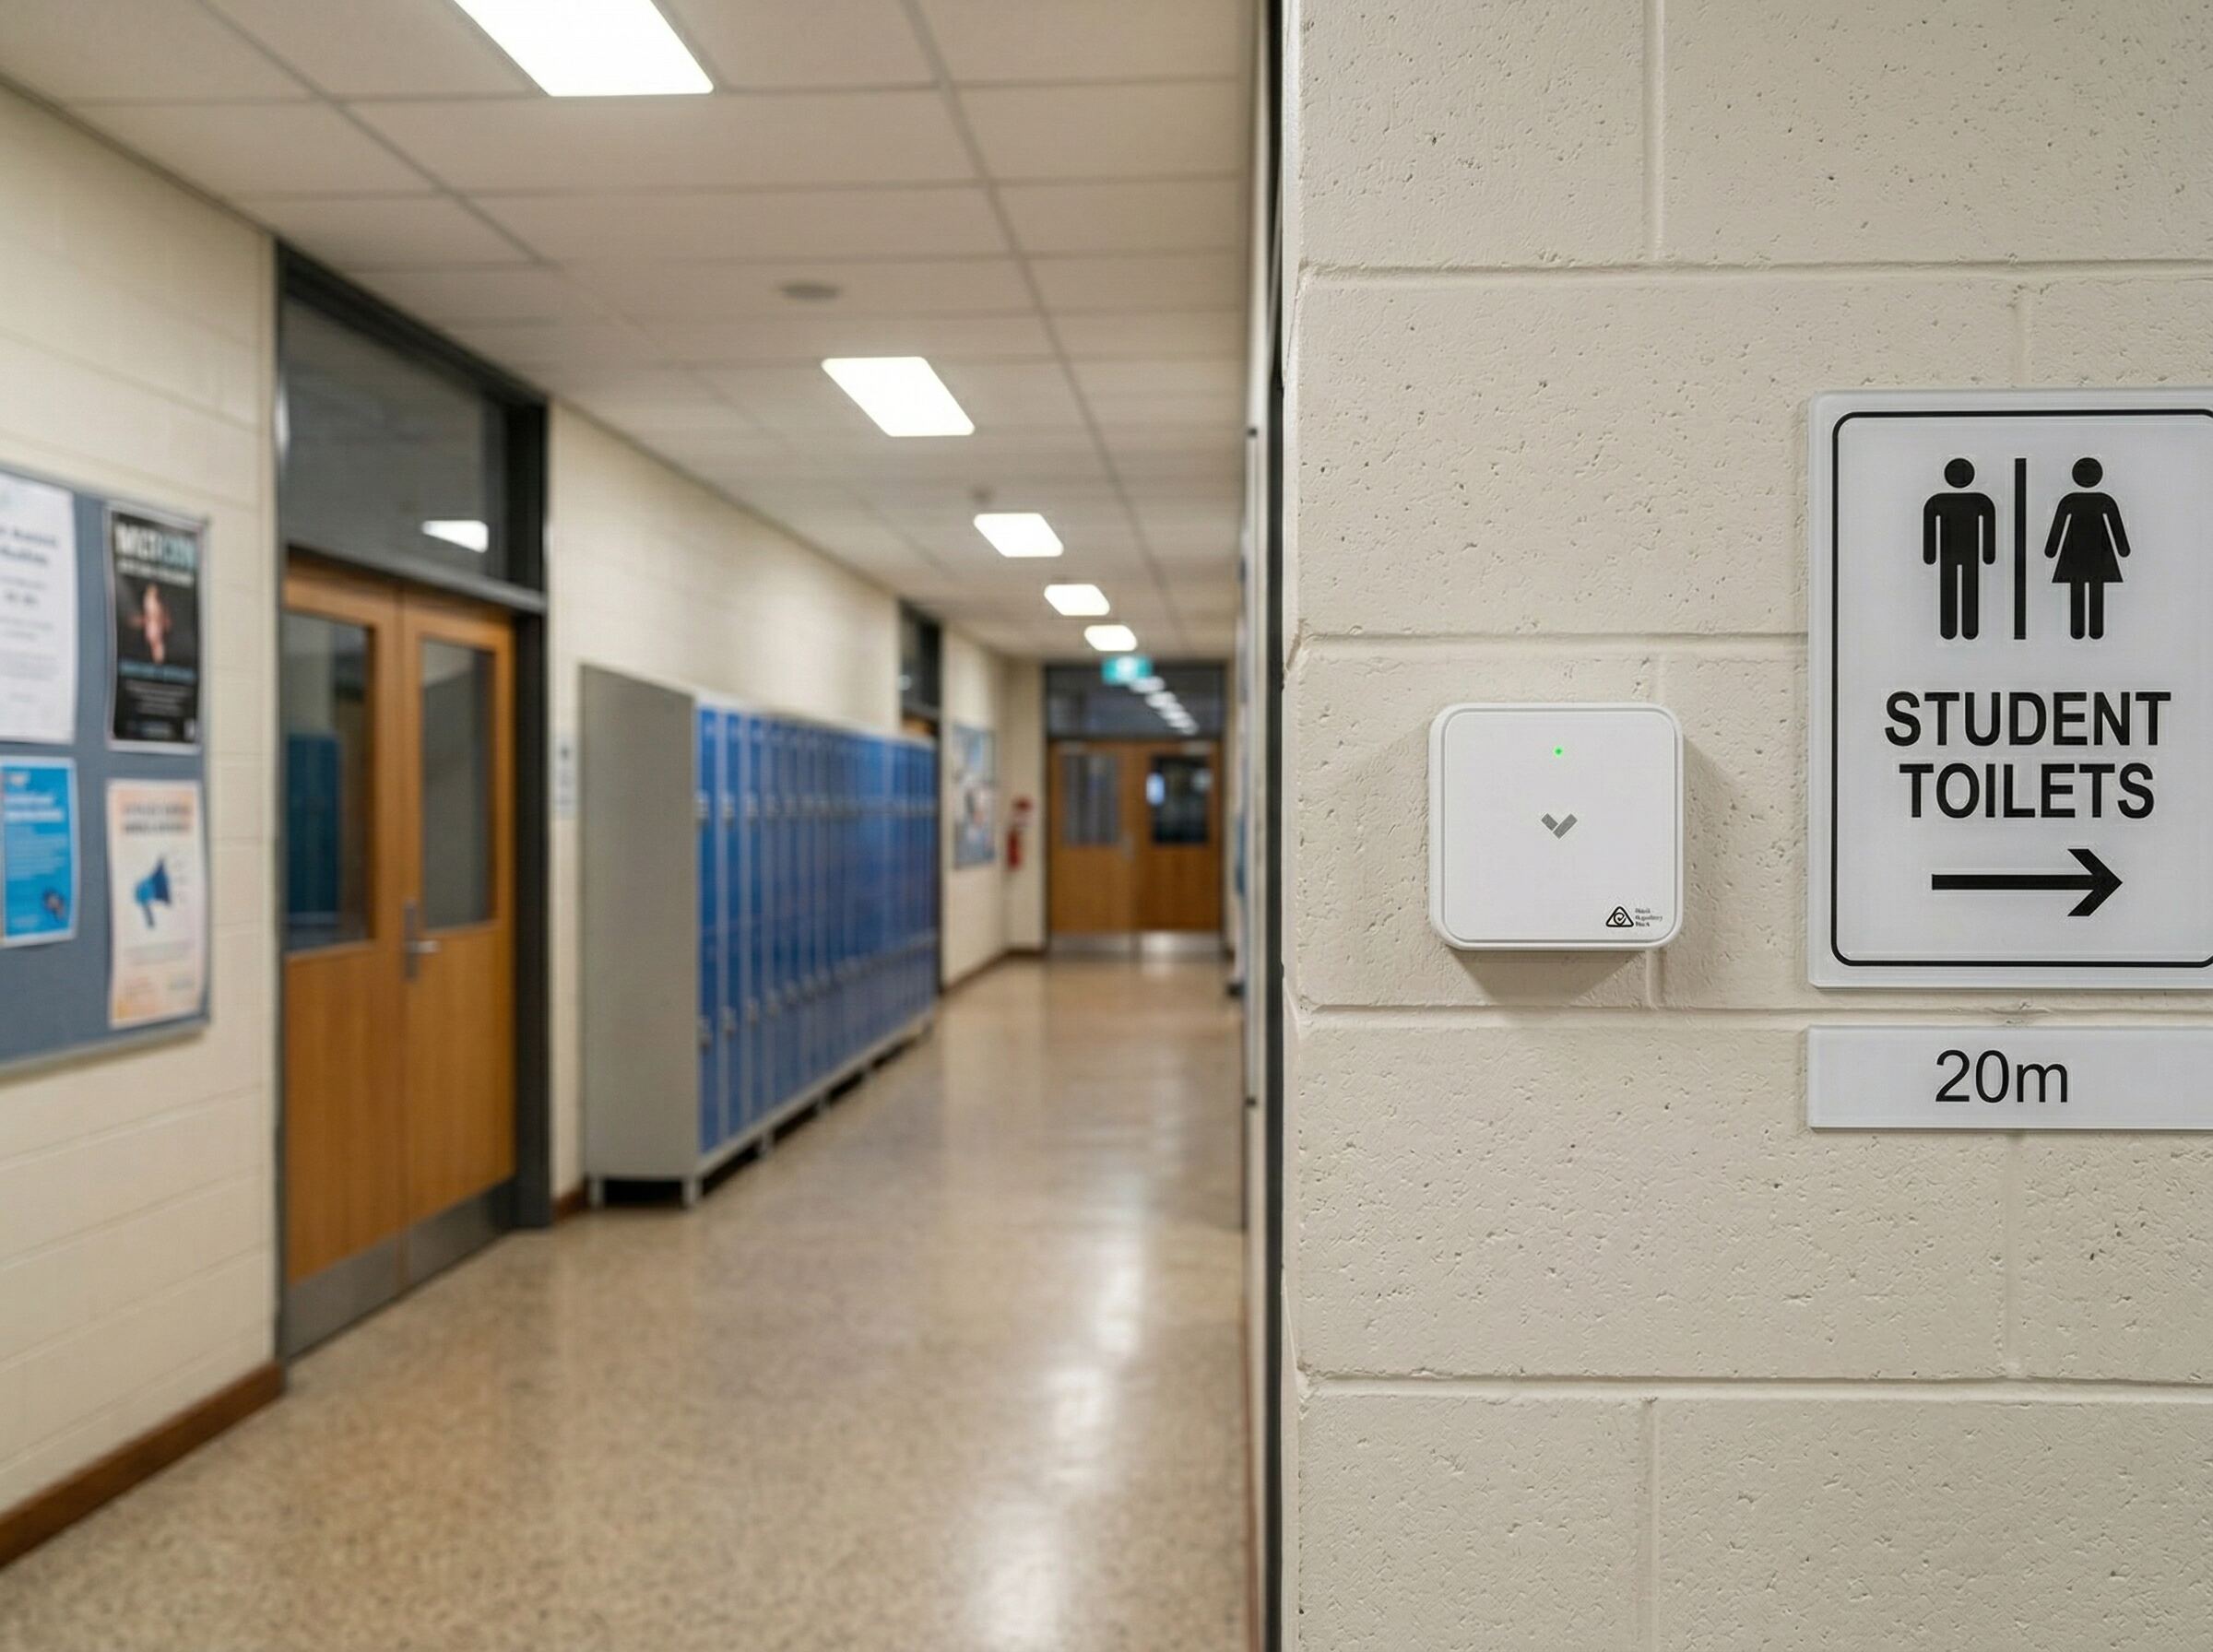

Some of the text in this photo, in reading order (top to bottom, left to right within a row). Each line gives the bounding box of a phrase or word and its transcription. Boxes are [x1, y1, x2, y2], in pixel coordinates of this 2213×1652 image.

[1884, 690, 2172, 748] STUDENT
[1899, 762, 2155, 820] TOILETS
[1935, 1049, 2068, 1103] 20m
